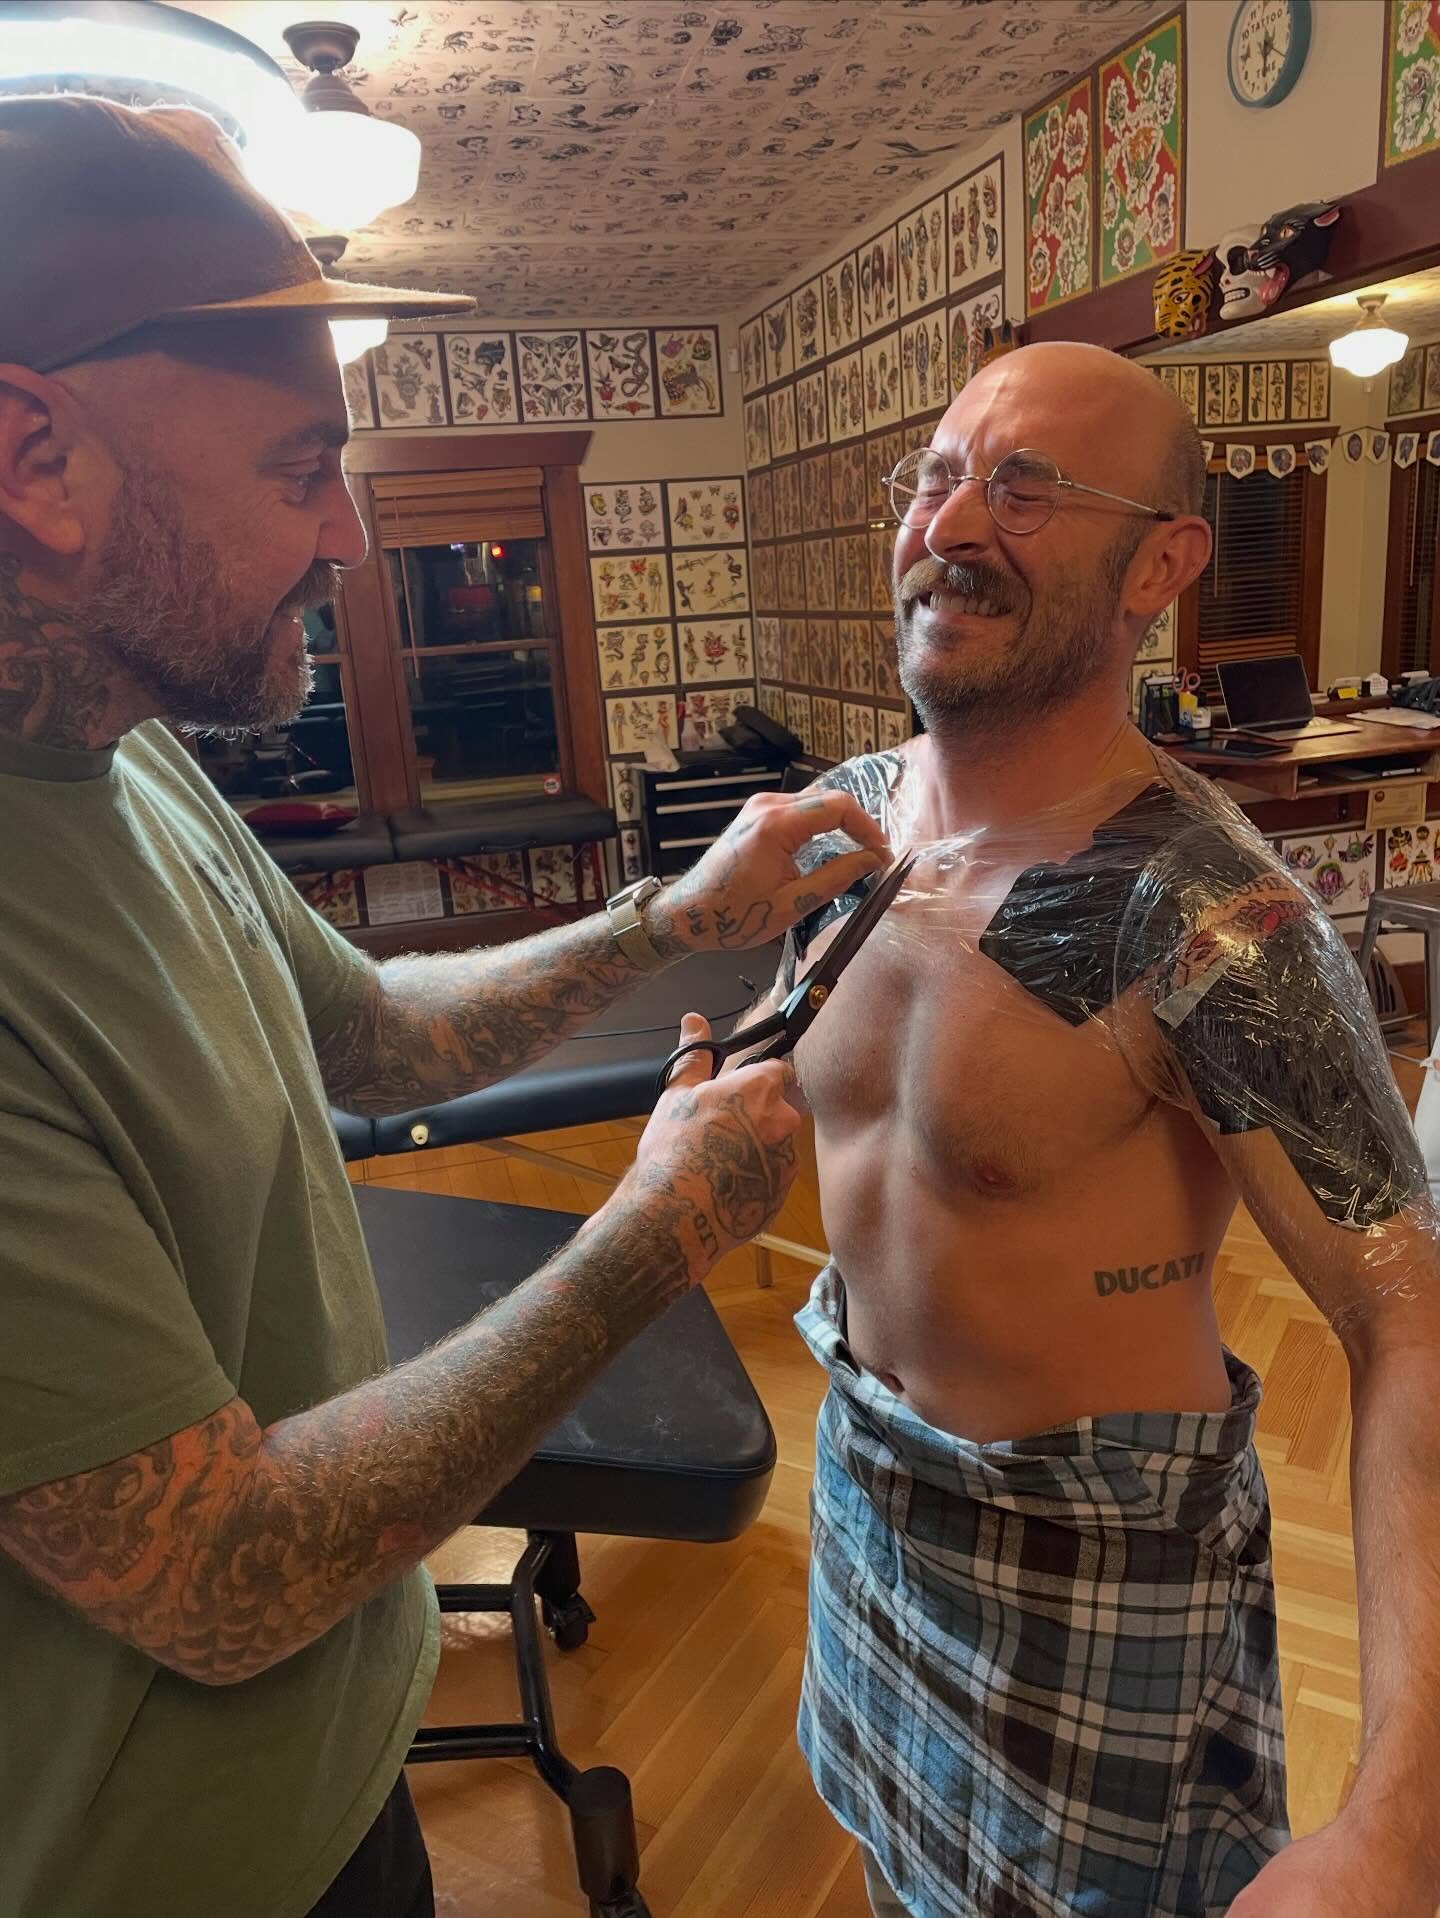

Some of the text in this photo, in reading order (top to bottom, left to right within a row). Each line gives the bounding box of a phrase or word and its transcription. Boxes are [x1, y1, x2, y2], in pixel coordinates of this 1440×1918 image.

[1251, 8, 1283, 33] TATTOO
[1242, 29, 1249, 40] 10
[1256, 60, 1276, 79] TME
[1094, 1252, 1205, 1296] DUCATI
